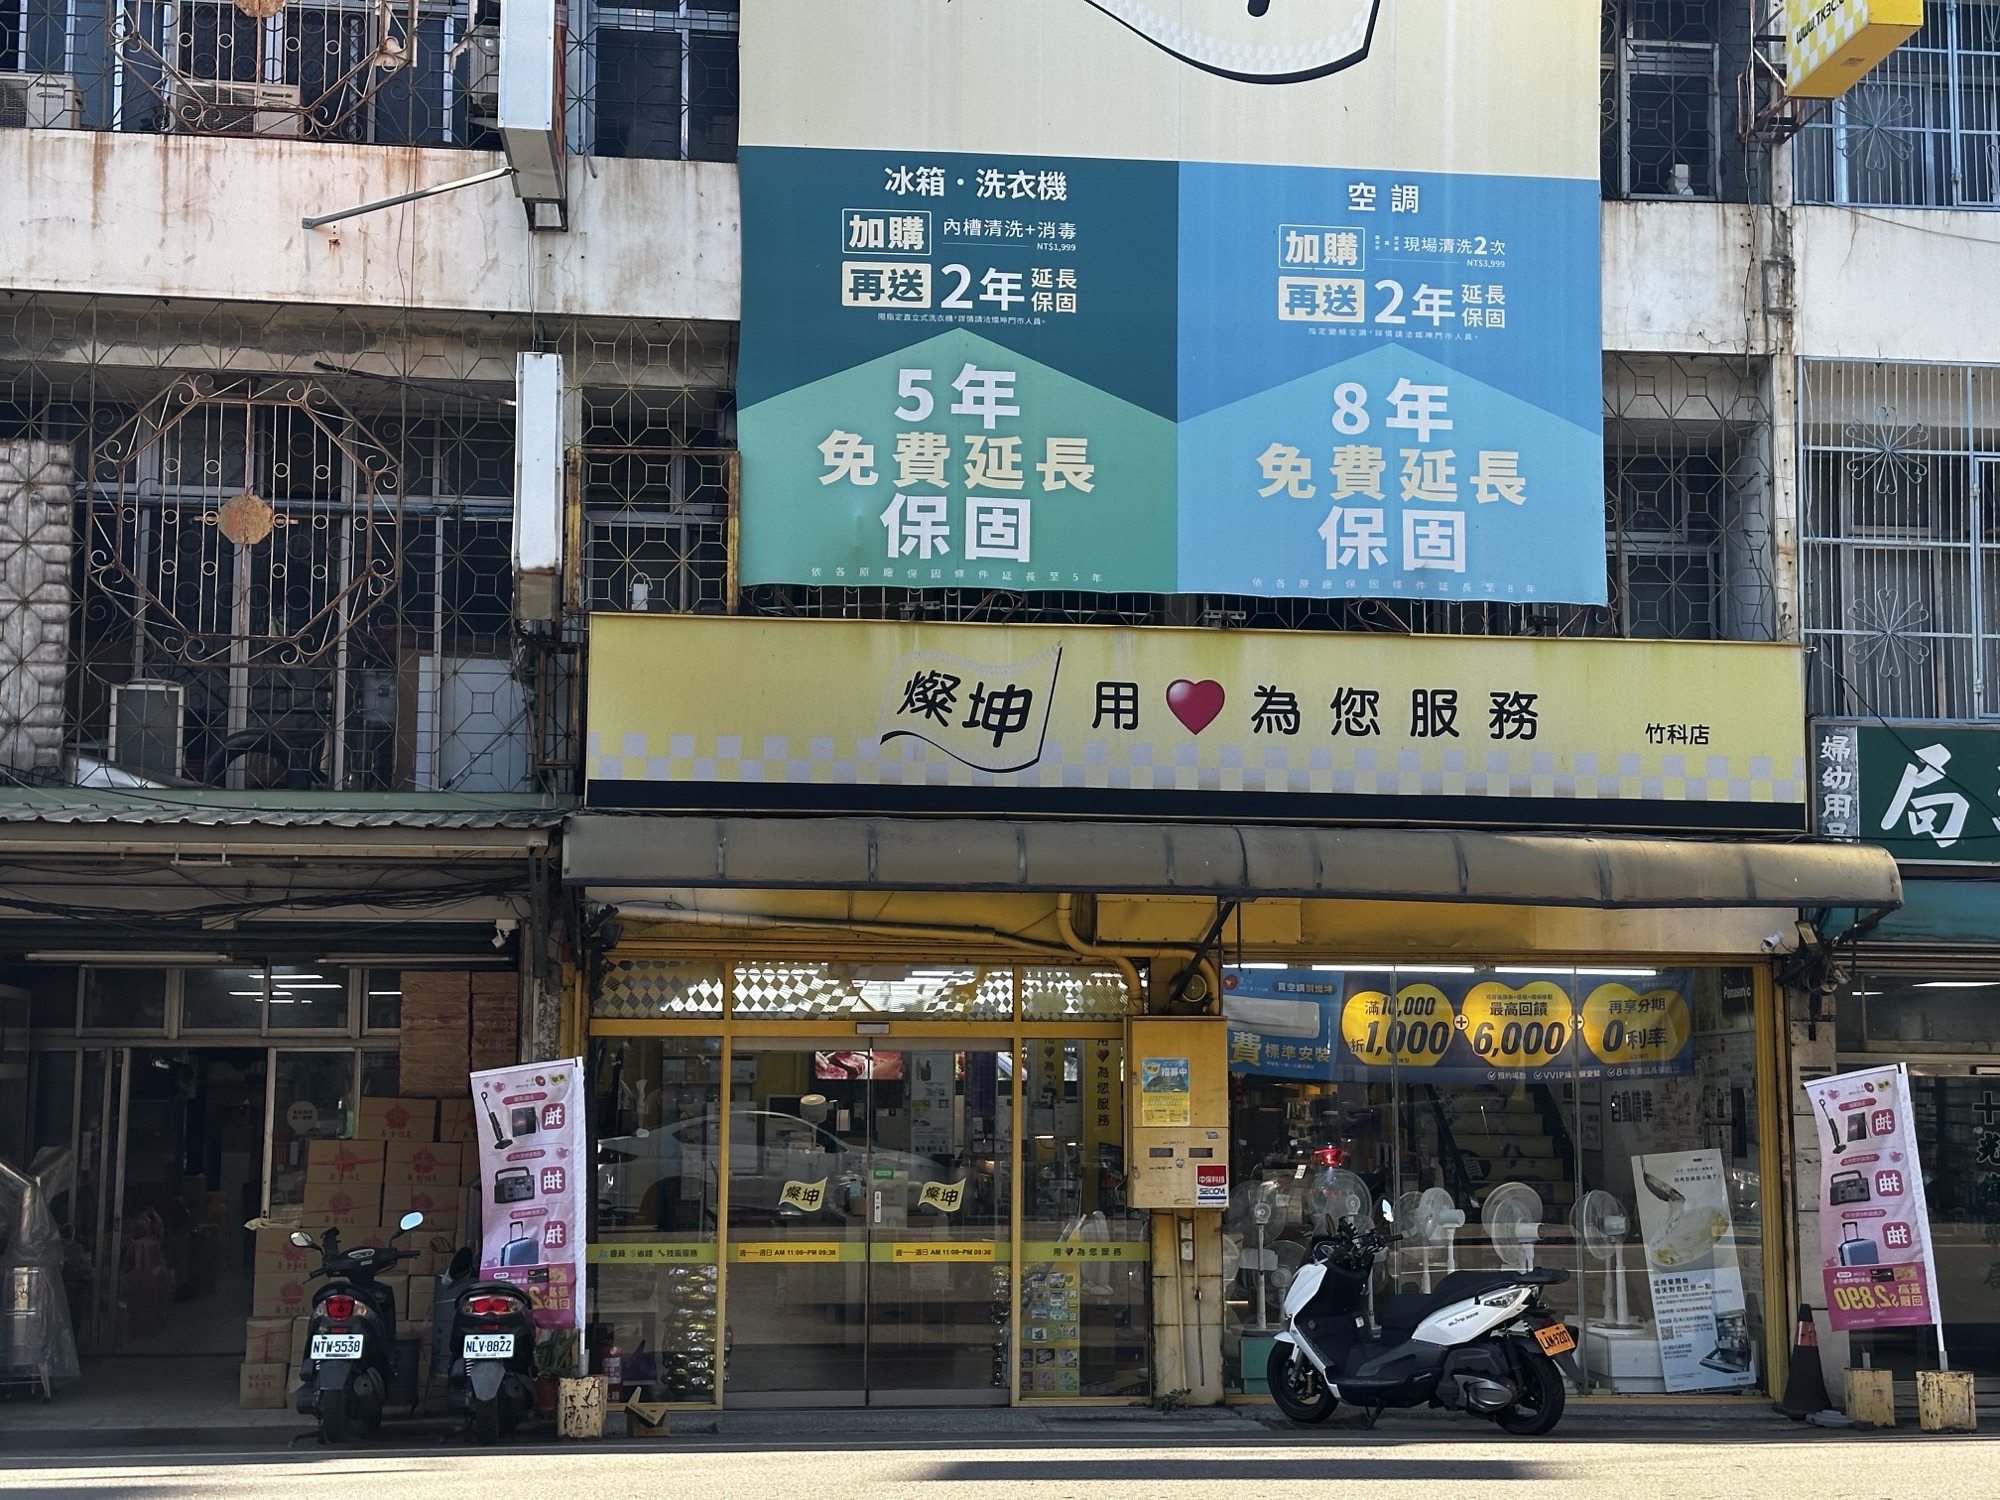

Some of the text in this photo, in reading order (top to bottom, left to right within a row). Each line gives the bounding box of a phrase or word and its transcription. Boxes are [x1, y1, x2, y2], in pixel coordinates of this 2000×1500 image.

[1348, 182, 1419, 213] 空調
[848, 214, 925, 250] 加購
[1036, 242, 1076, 252] NT$1,999
[1285, 231, 1358, 266] 加購
[1466, 259, 1505, 268] NT$3,999
[848, 263, 1025, 311] 再送 2年
[1031, 268, 1077, 290] 延長
[1031, 291, 1077, 313] 保固
[1285, 279, 1455, 326] 再送 2年
[1461, 284, 1505, 305] 延長
[1461, 307, 1505, 328] 保固
[894, 362, 1020, 429] 5年
[1331, 378, 1453, 442] 8年
[817, 429, 1095, 493] 免費延長
[1257, 443, 1527, 506] 免費延長
[880, 493, 1031, 562] 保固
[1318, 506, 1466, 573] 保固
[896, 669, 1033, 748] 燦坤
[1645, 722, 1710, 745] 竹科店
[1723, 986, 1752, 999] Panasonc
[1489, 1002, 1548, 1016] 最高回饋
[1608, 998, 1666, 1014] 再享分期
[1472, 1022, 1566, 1057] 6,000
[784, 1185, 821, 1206] 燦坤
[923, 1185, 959, 1207] 燦坤
[1199, 1187, 1225, 1195] SECOM
[313, 1340, 361, 1353] NTW-5538
[465, 1340, 512, 1353] NLV-8822
